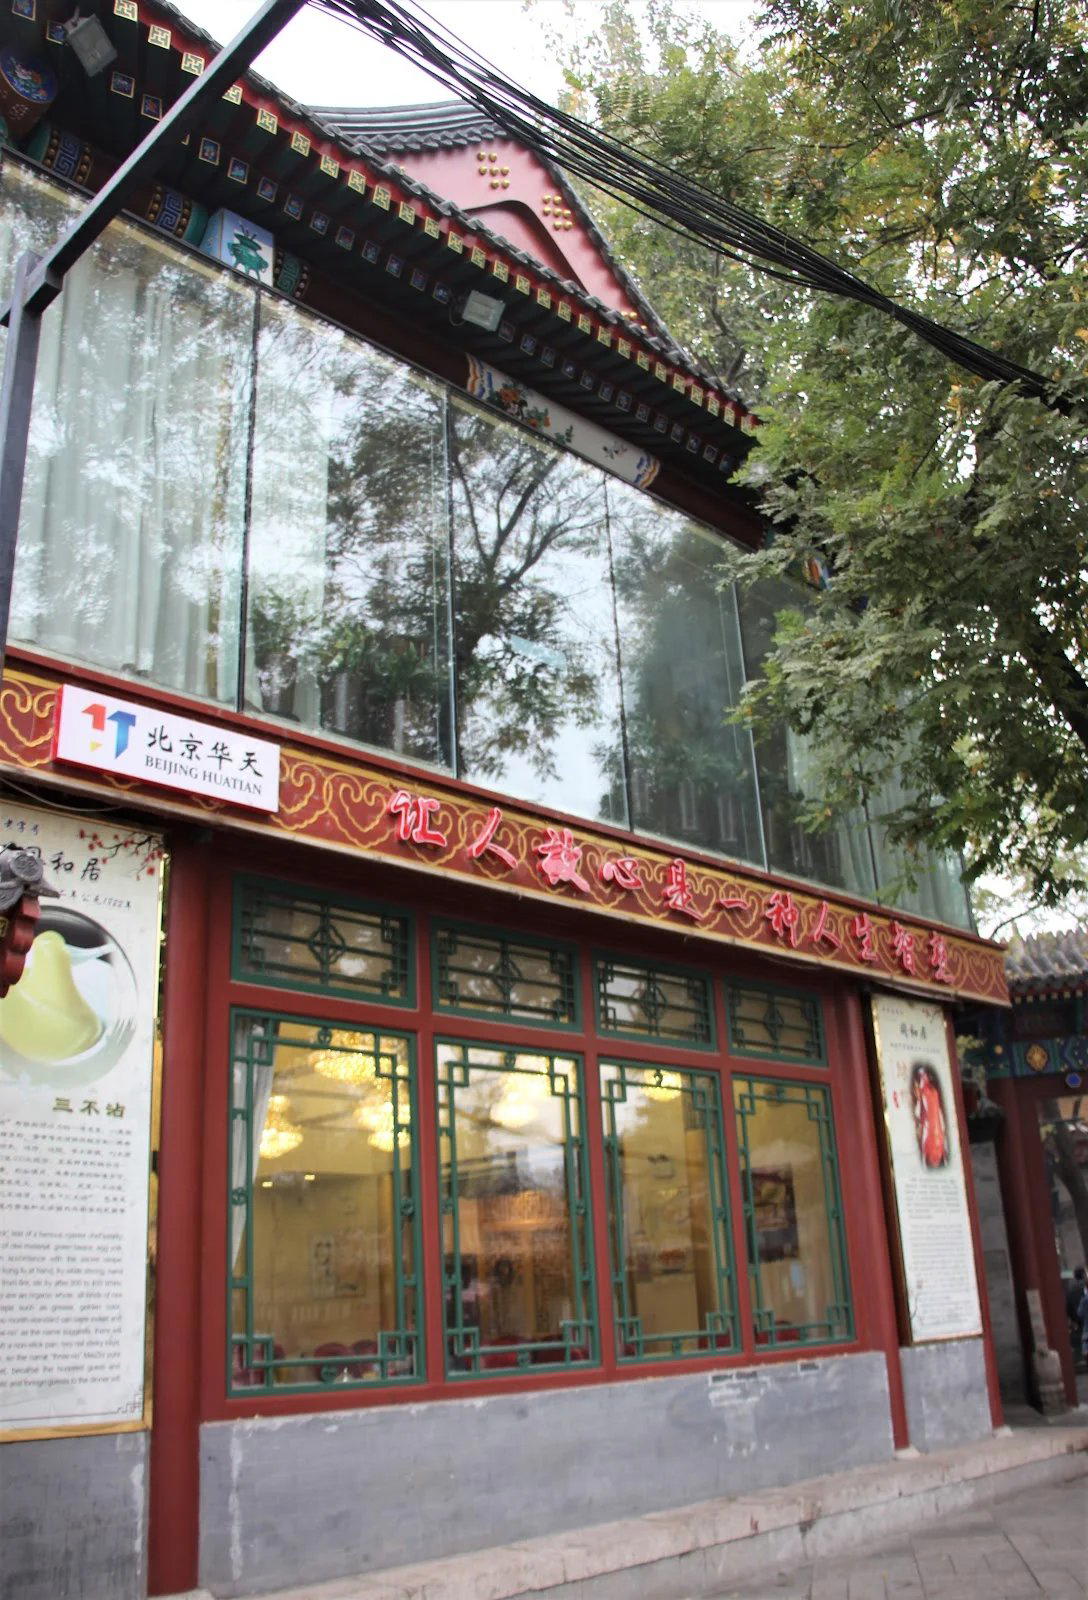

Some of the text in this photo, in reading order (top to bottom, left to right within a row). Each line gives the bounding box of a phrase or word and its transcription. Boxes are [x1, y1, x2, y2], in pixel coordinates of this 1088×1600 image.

[147, 725, 264, 778] 北京华天
[145, 755, 263, 796] BEIJING HUATIAN
